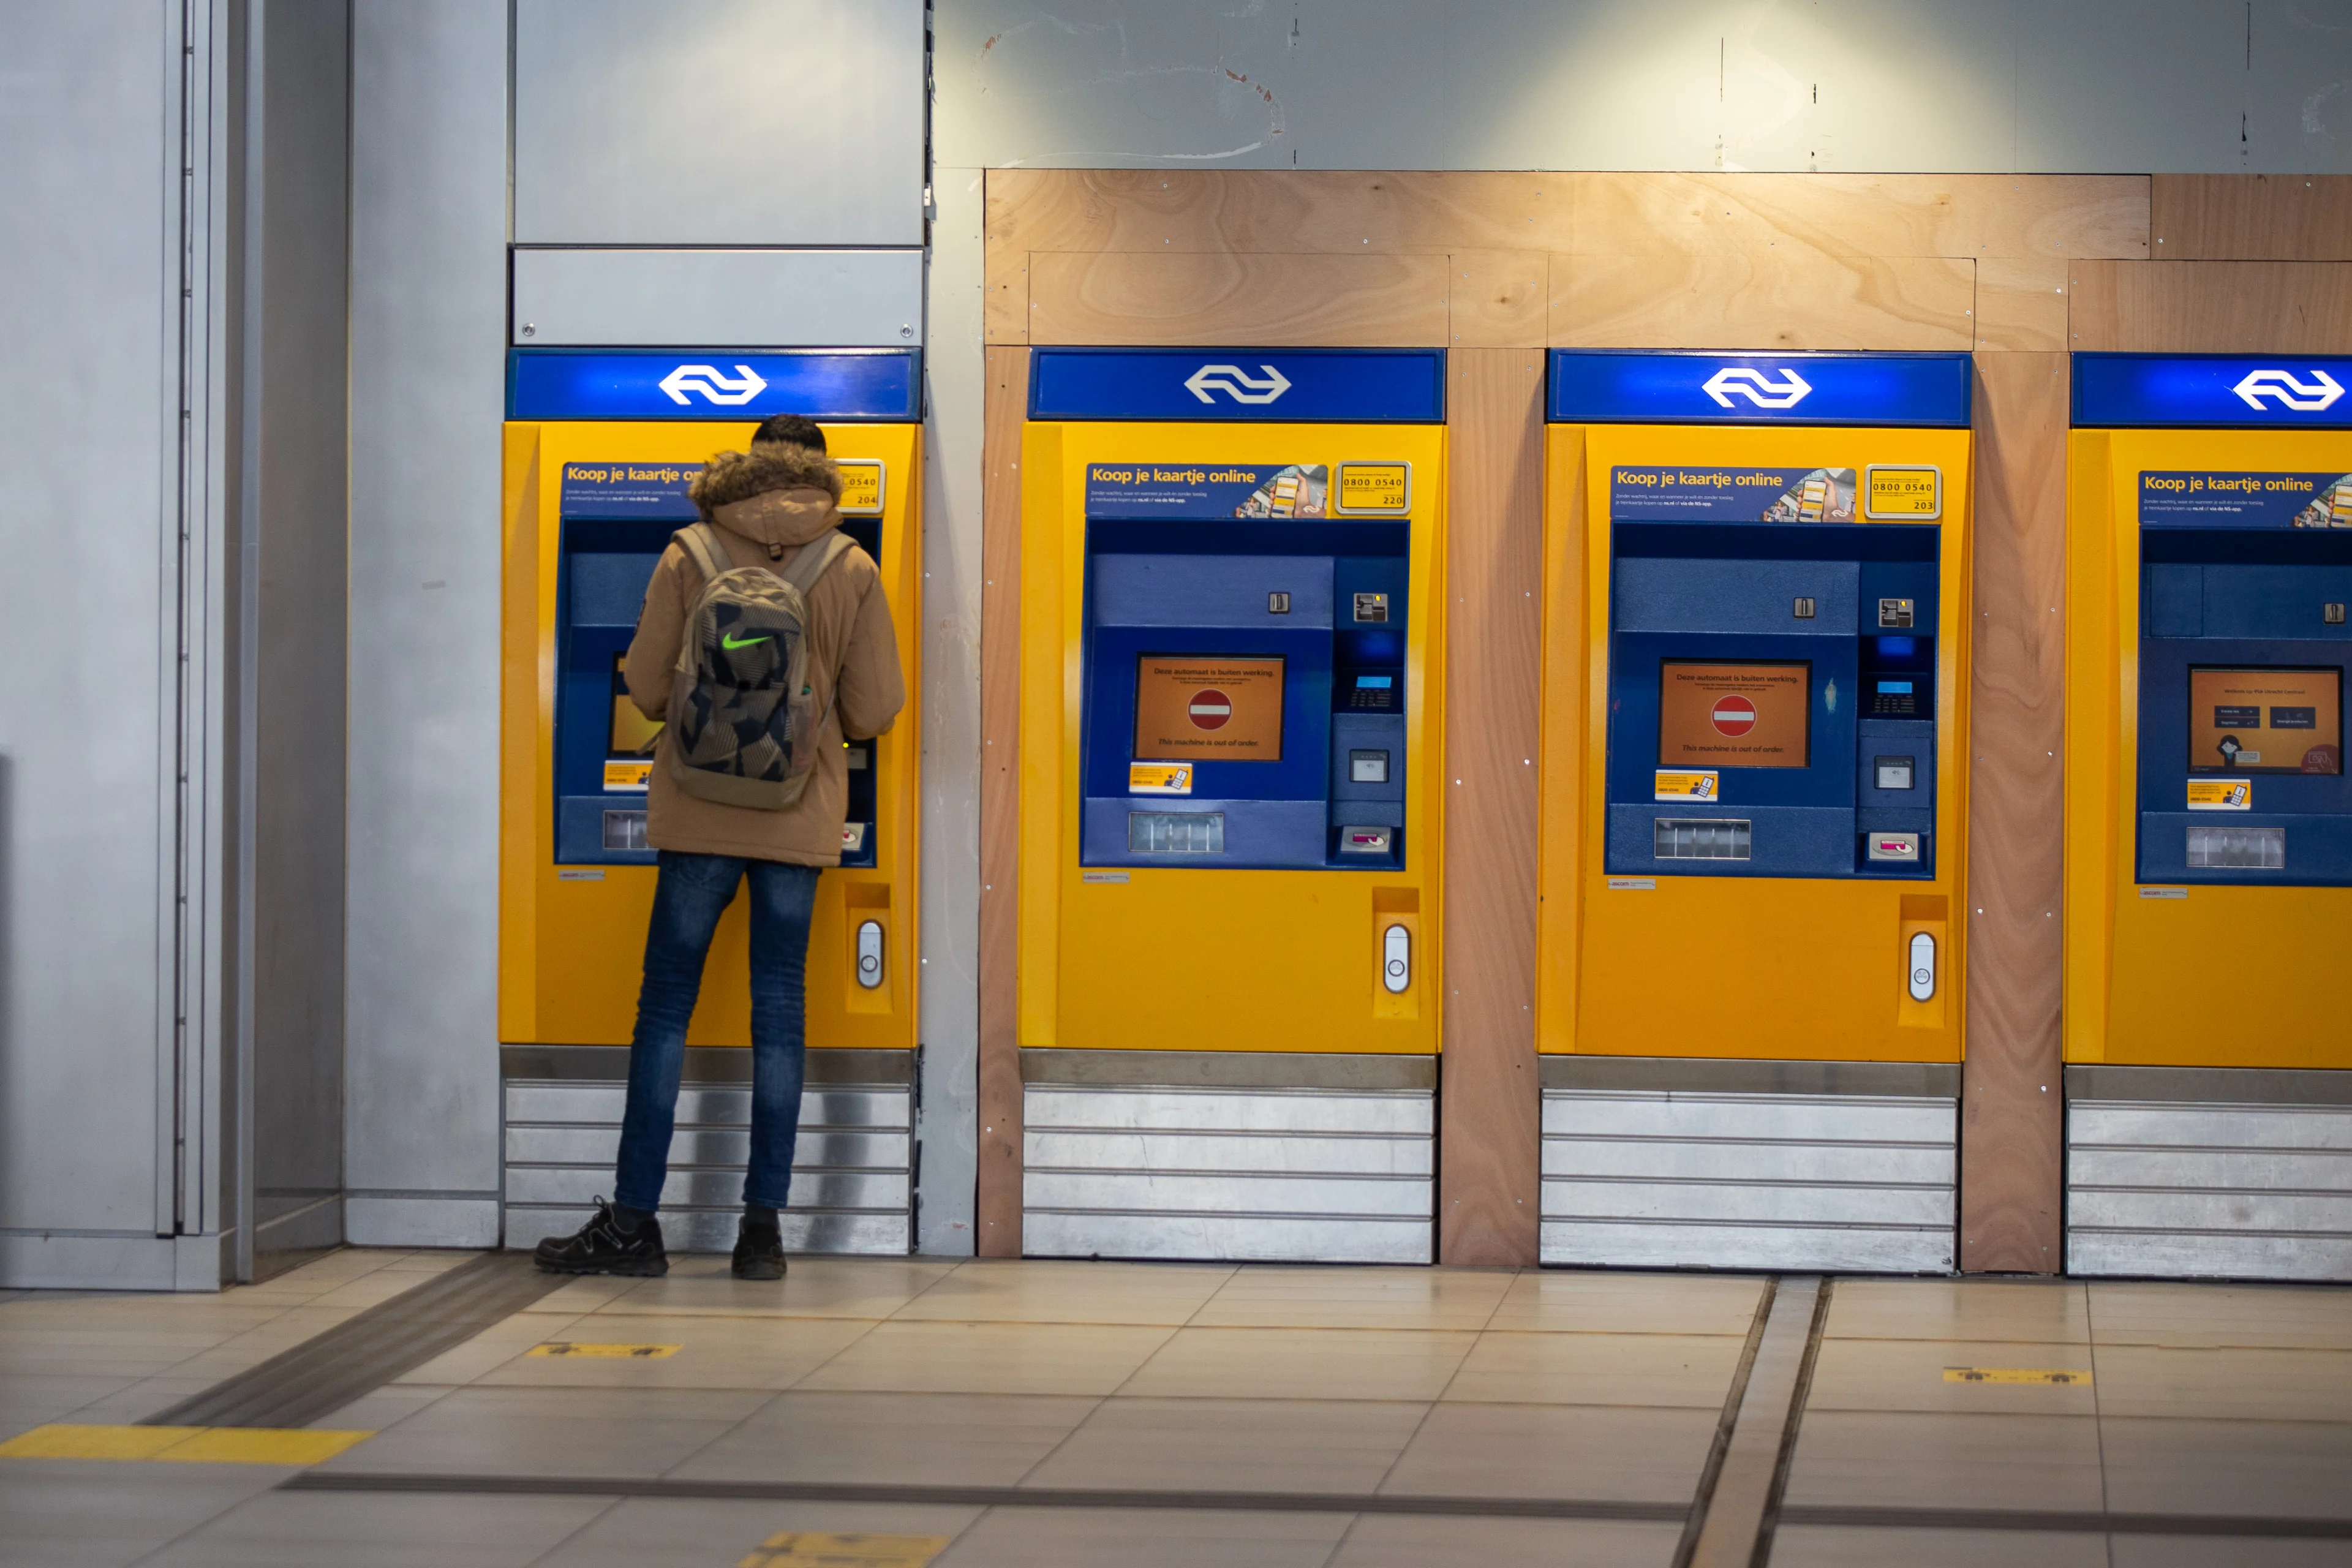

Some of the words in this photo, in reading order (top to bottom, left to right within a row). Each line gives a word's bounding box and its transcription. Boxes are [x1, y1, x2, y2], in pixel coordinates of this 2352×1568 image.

[568, 467, 607, 483] Koop
[610, 467, 624, 483] je
[628, 467, 679, 483] kaartje
[1093, 469, 1132, 484] Koop
[1136, 469, 1150, 484] je
[1154, 469, 1205, 484] kaartje
[1209, 470, 1256, 483] online
[1618, 472, 1657, 487] Koop
[1661, 472, 1675, 488] je
[1679, 472, 1732, 488] kaartje
[1736, 473, 1782, 486] online
[2146, 477, 2186, 492] Koop
[2190, 477, 2204, 492] je
[2208, 477, 2261, 493] kaartje
[2265, 478, 2313, 491] online
[1243, 669, 1275, 678] werking.
[1766, 676, 1799, 684] werking.
